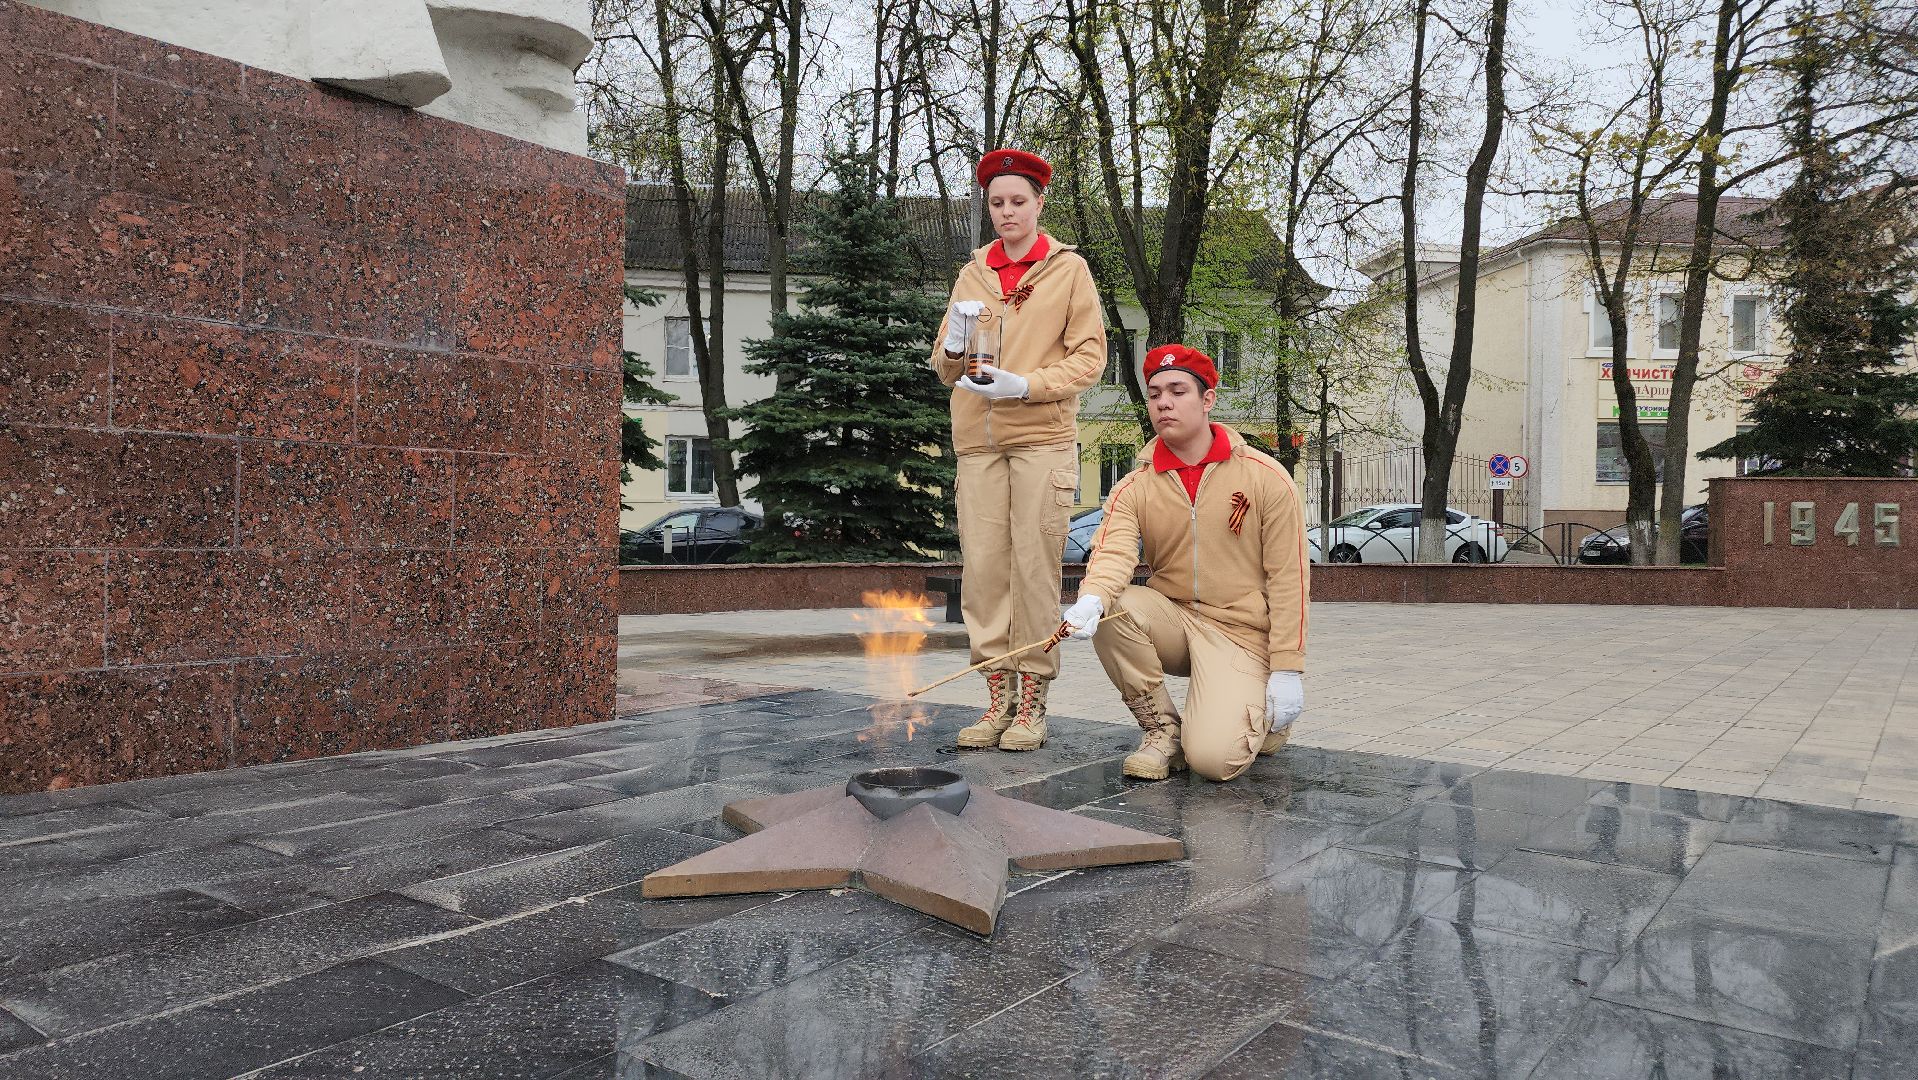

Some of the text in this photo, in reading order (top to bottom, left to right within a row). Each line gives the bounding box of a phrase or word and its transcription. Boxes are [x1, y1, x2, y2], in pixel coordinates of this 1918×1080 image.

[1601, 368, 1675, 379] ХЧИСТ
[1514, 463, 1520, 471] 5
[1763, 501, 1900, 547] 1945
